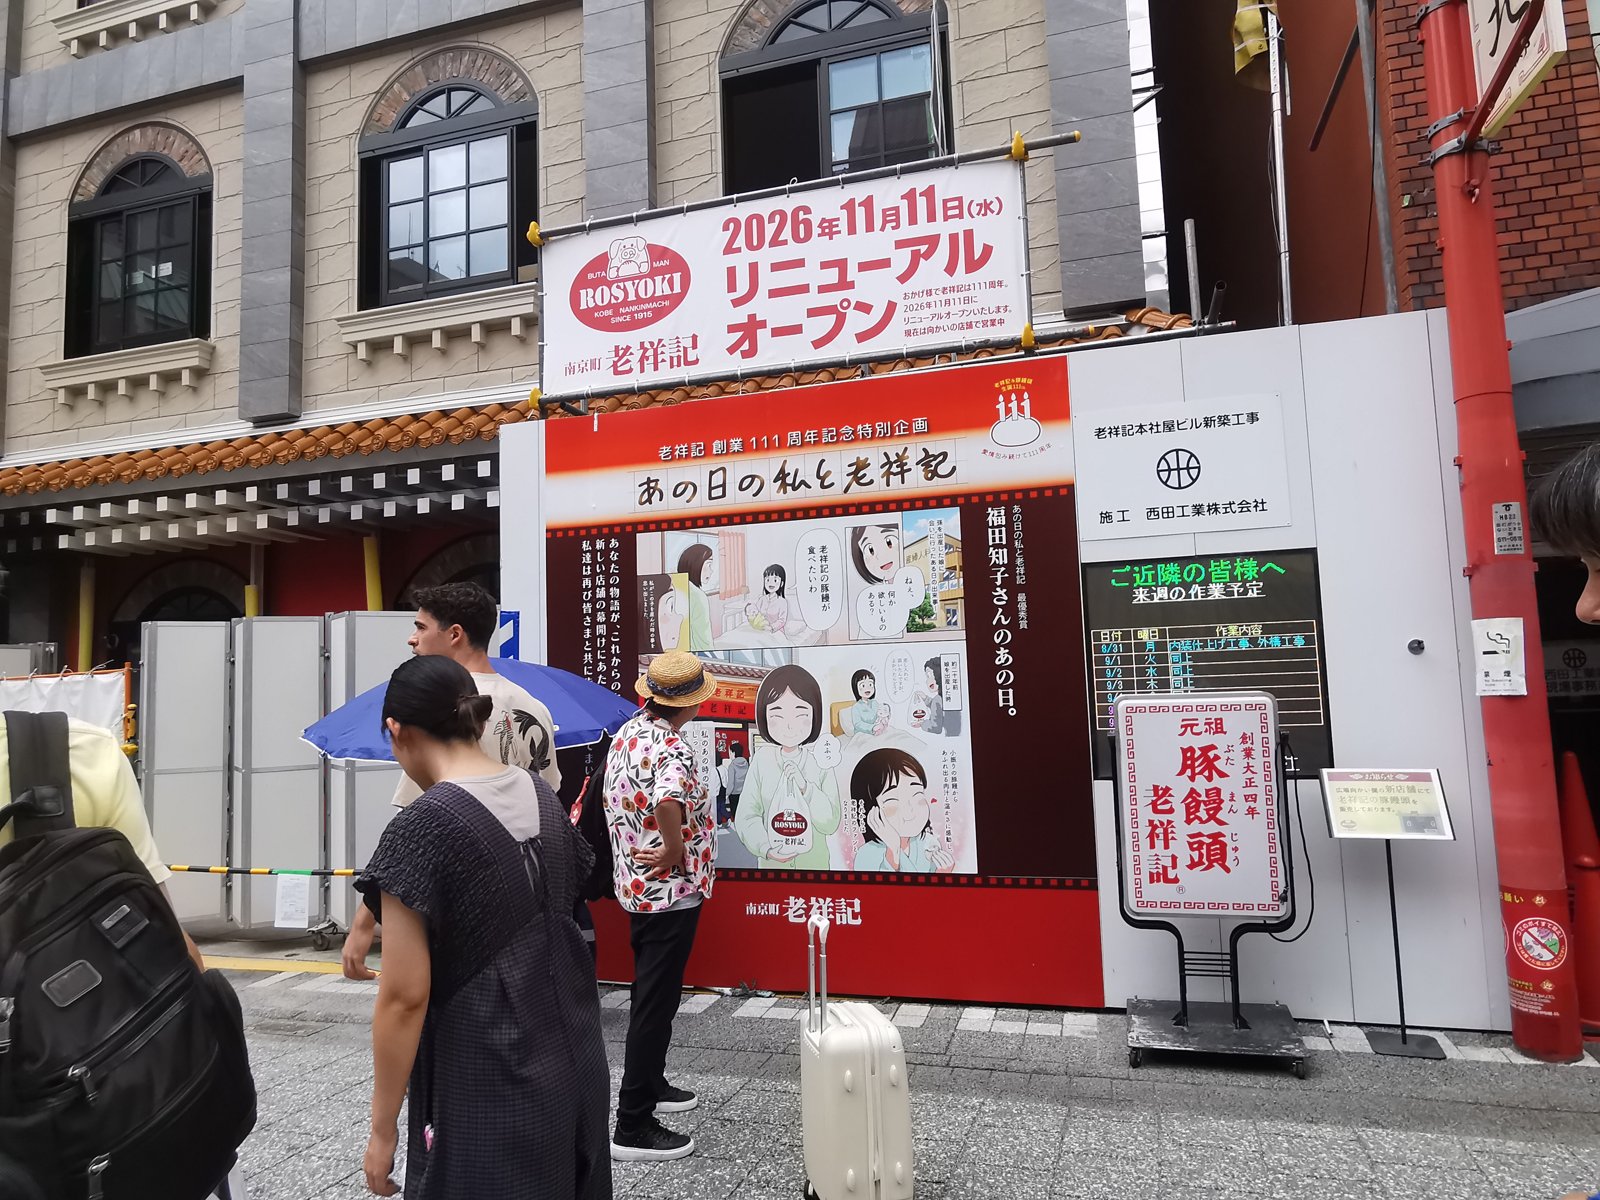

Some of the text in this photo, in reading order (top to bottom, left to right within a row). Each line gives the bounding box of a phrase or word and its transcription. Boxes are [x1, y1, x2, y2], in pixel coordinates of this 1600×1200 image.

[722, 184, 1003, 255] 2026年11月11日(水)
[588, 259, 669, 280] BUTA MAN
[726, 229, 994, 308] リニューアル
[579, 272, 682, 310] ROSYOKI
[903, 280, 1009, 301] おかげ様で老祥記は111周年。
[904, 295, 978, 313] 2026年11月11日に
[594, 300, 669, 318] KOBE NANKINMACHI
[610, 311, 653, 324] SINCE 1915
[904, 305, 1012, 326] リニューアルオープンいたします。
[725, 298, 898, 360] オープン
[904, 318, 1005, 338] 現在は向かいの店舗で営業中
[564, 333, 699, 376] 南京町 老祥記
[658, 416, 928, 461] 老祥記 創業 111 周年記念特別企画
[1094, 411, 1260, 440] 老祥記本社屋ビル新築工事
[638, 447, 957, 506] あの日の私と老祥記
[1099, 498, 1268, 525] 施工 西田工業株式会社
[807, 545, 818, 593] 食べたいわ
[819, 545, 831, 612] 老祥記の豚饅が
[1012, 504, 1029, 630] あの日の私と老祥記 最優秀賞
[1111, 557, 1287, 588] ご近隣の皆様へ
[888, 590, 896, 606] 何か
[1132, 581, 1266, 602] 来週の作業予定
[581, 540, 594, 682] 私達は再び皆さまと共に
[609, 538, 621, 698] あなたの物語が、これからの
[877, 591, 887, 631] 欲しいもの
[986, 506, 1017, 717] 福田知子さんのあの日。
[1100, 624, 1263, 642] 日付 曜日 作業内容
[1101, 635, 1305, 653] 8/31 月 内装仕上げ工事、外構工事
[1105, 653, 1193, 665] 9/1 火 同上
[1105, 665, 1194, 678] 9/2 水 同上
[1106, 678, 1195, 690] 9/3 木 同上
[1545, 668, 1600, 680] 西田工業
[1546, 680, 1600, 693] 現場事務
[1178, 717, 1227, 736] 元祖
[1239, 732, 1260, 820] 創業大正四年
[1176, 744, 1231, 874] 豚饅頭
[1224, 744, 1240, 867] ぶた まん じゅう
[774, 821, 805, 829] ROSYOKI
[1143, 784, 1180, 885] 老祥記
[746, 895, 862, 925] 南京町 老祥記
